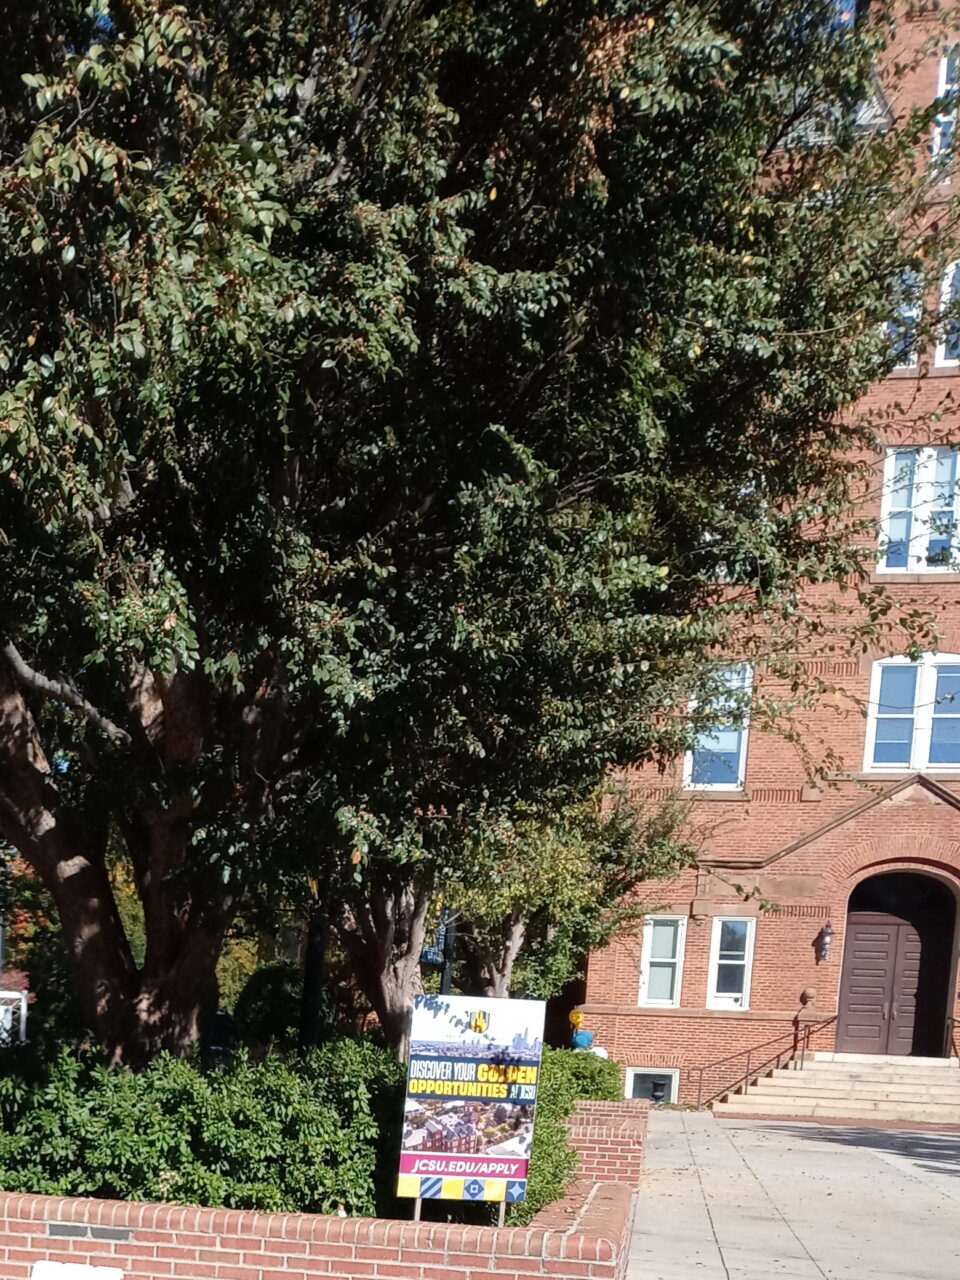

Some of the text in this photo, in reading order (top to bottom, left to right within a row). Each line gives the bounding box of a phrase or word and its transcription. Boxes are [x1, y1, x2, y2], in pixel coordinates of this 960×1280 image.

[410, 1060, 538, 1084] DISCOVER YOUR GOLDEN
[408, 1079, 508, 1098] OPPORTUNITIES
[509, 1084, 520, 1099] AT
[411, 1159, 519, 1175] JCSU.EDU/APPLY
